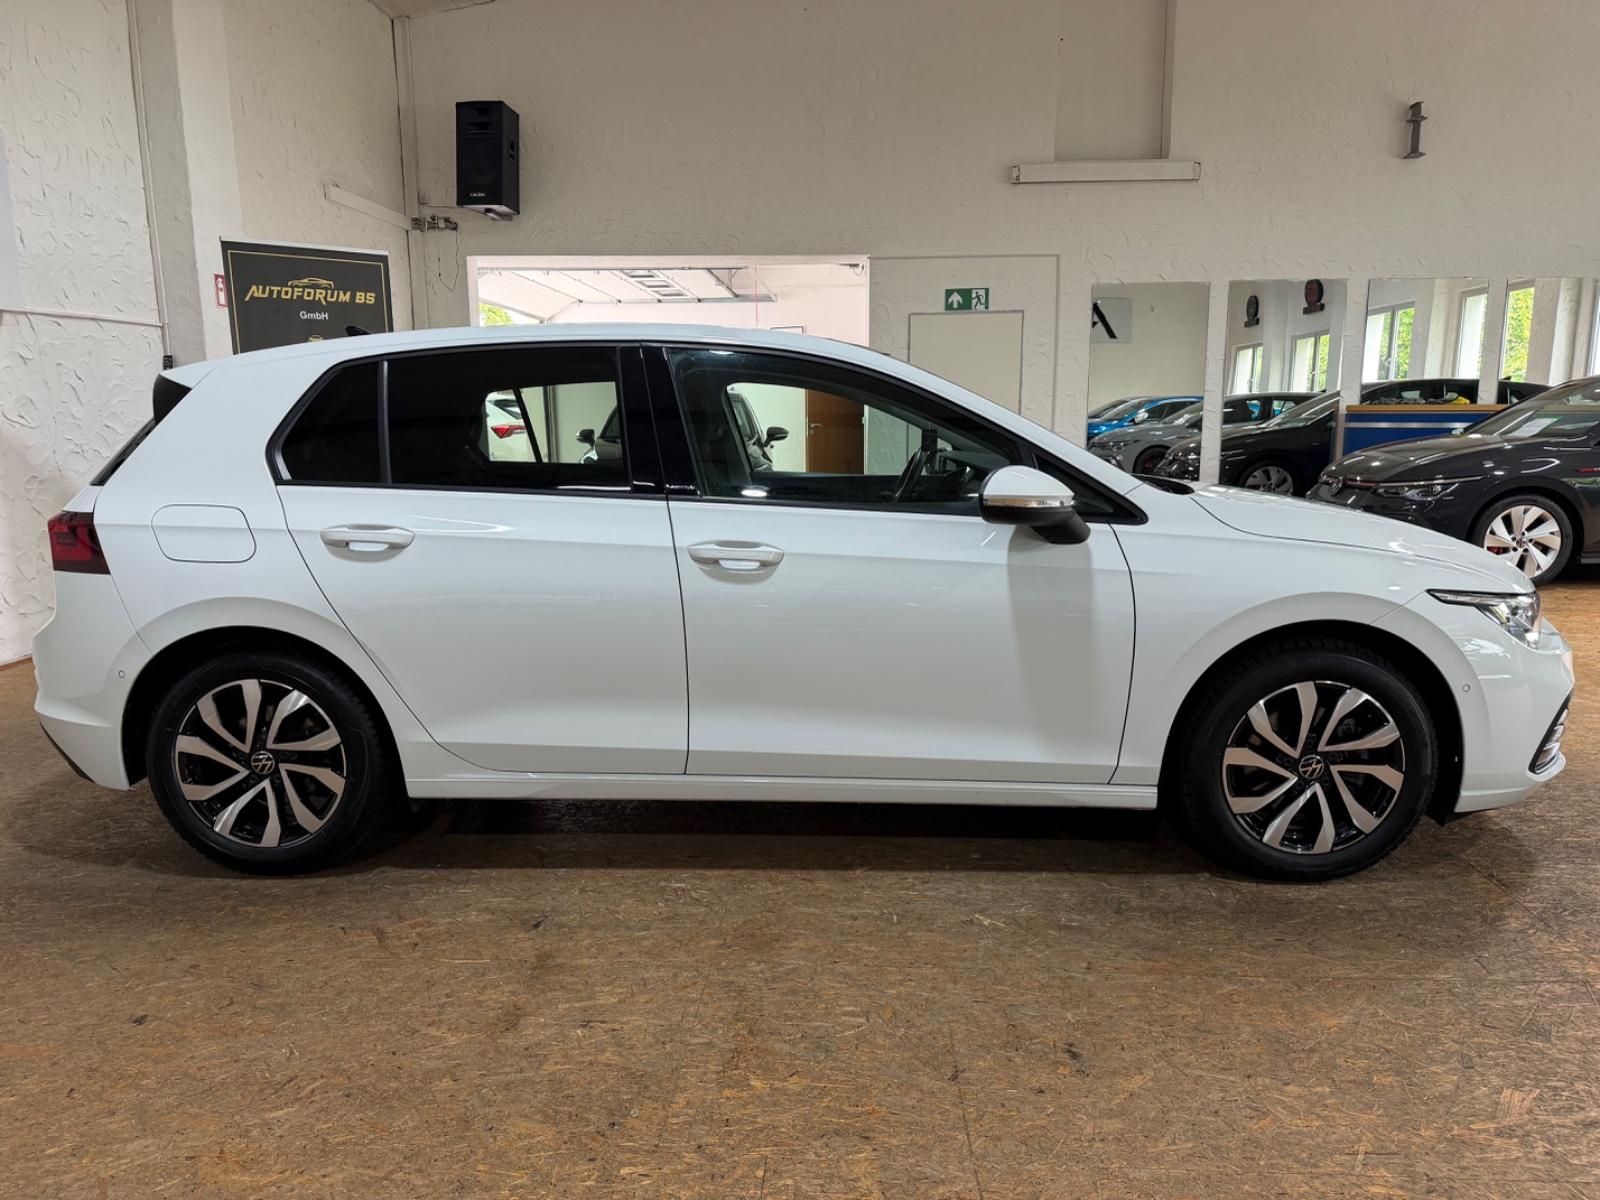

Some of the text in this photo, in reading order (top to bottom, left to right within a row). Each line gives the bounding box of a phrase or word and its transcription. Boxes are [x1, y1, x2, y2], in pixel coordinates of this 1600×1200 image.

[245, 285, 376, 305] AUTOFORUM BS
[300, 310, 328, 320] GmbH
